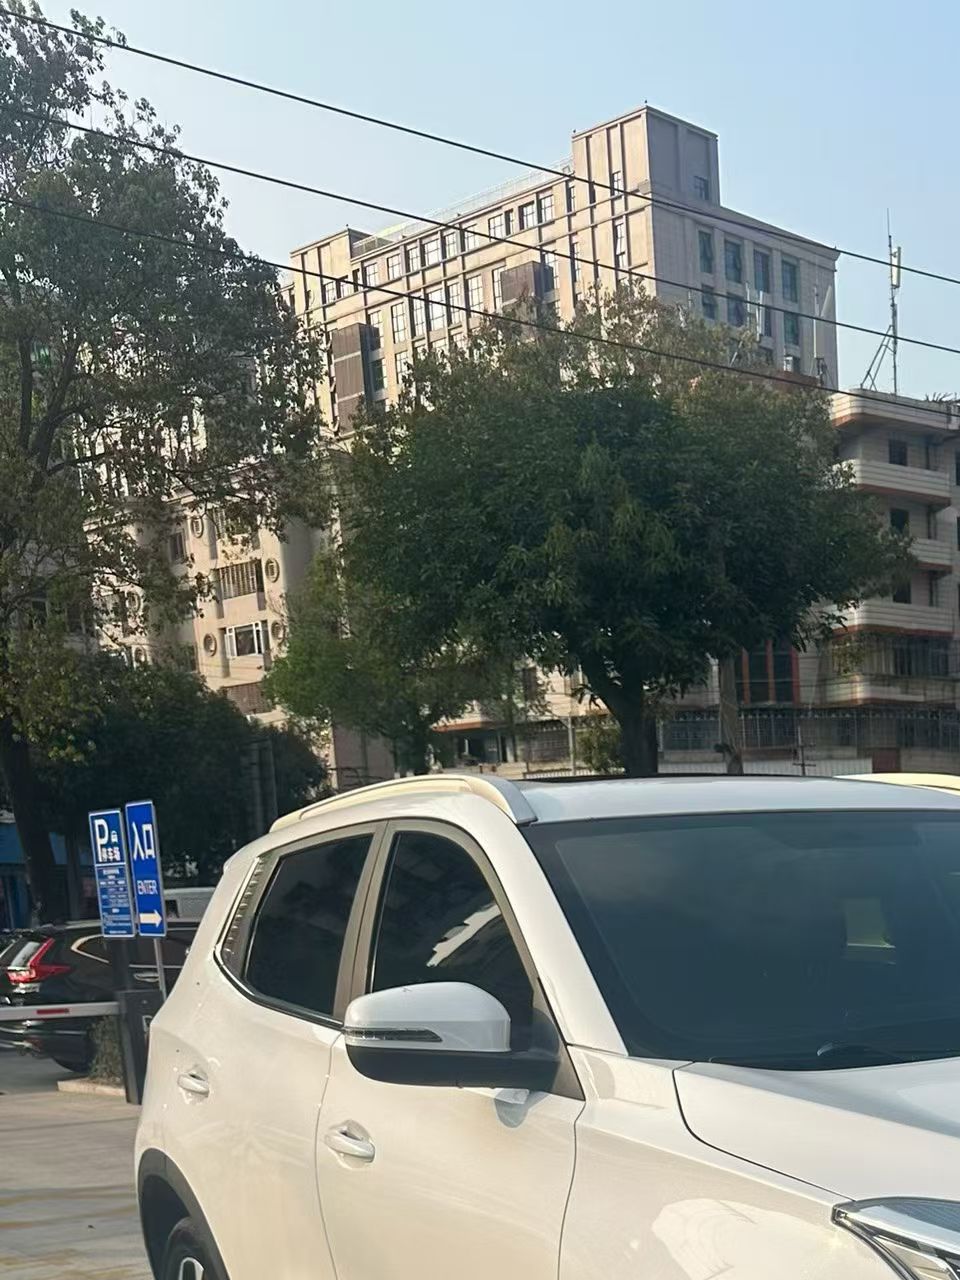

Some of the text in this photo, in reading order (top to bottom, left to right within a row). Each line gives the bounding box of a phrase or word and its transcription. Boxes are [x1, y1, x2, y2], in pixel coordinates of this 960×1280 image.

[94, 819, 109, 862] P
[132, 821, 156, 861] 入口
[137, 880, 158, 895] ENTER
